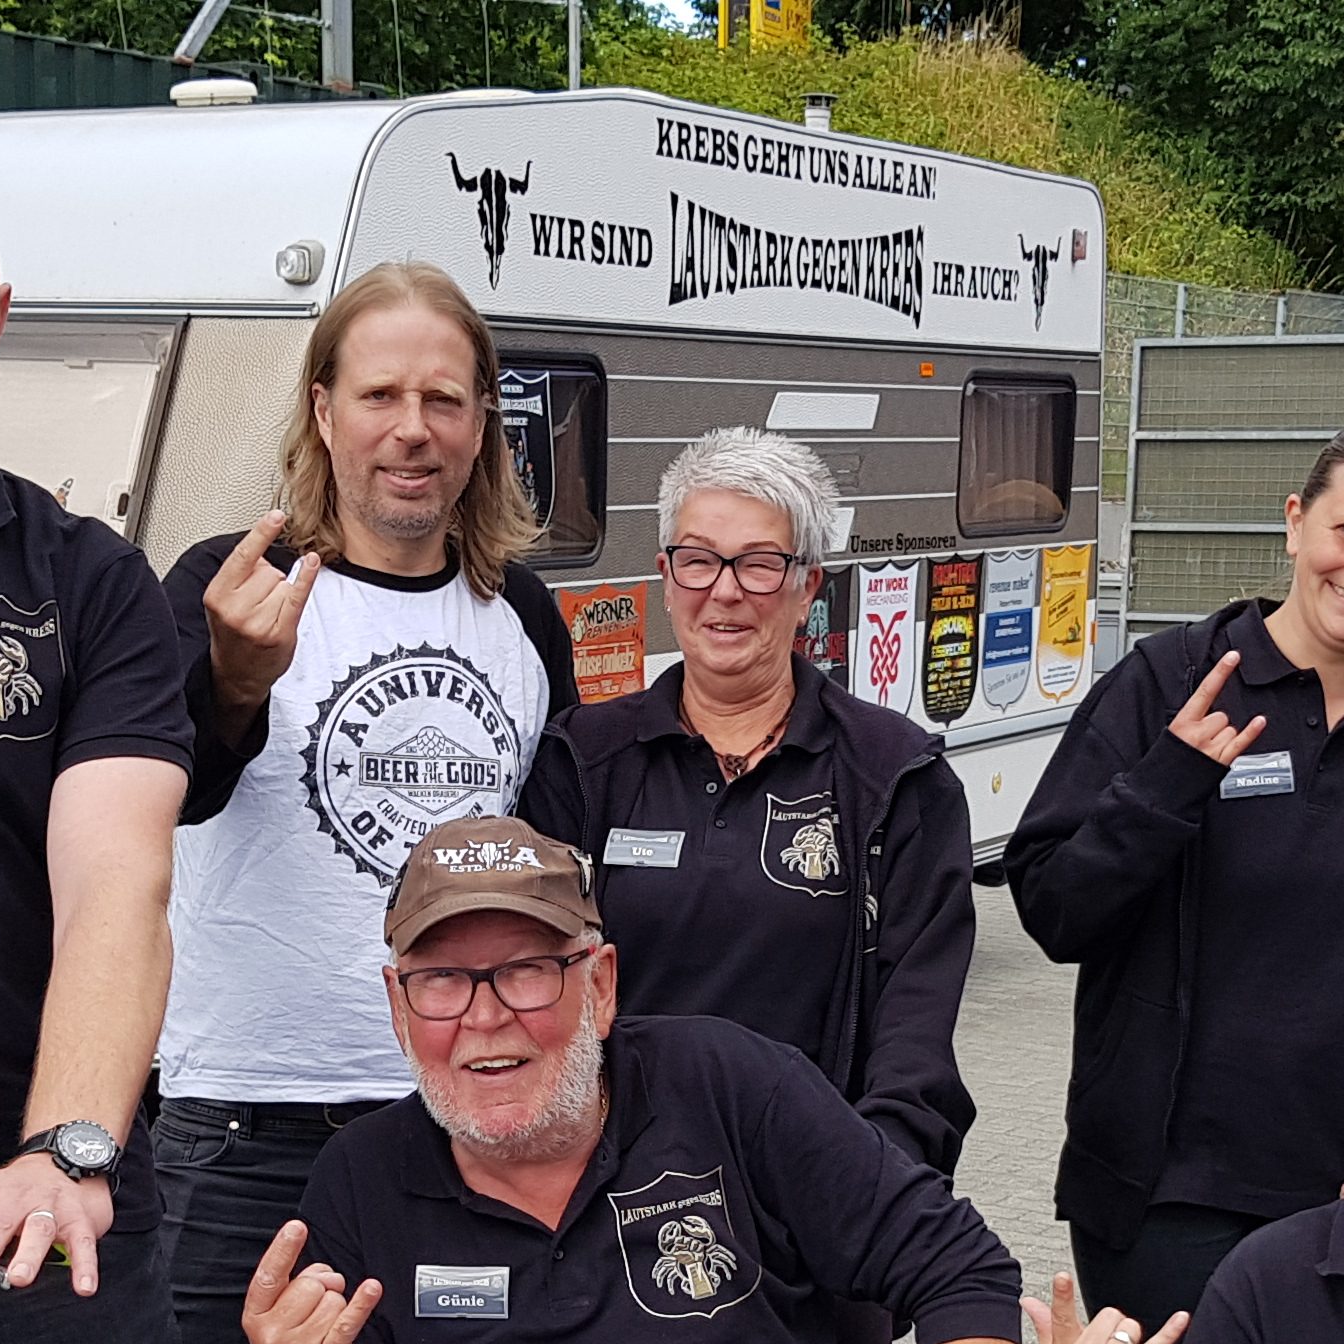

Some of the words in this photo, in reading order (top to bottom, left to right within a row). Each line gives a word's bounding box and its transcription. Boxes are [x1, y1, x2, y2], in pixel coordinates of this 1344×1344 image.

[657, 117, 739, 171] KREBS
[743, 134, 806, 180] GEHT
[808, 146, 849, 188] UNS
[852, 154, 904, 195] ALLE
[906, 163, 937, 200] AN!
[529, 212, 586, 261] WIR
[591, 220, 653, 268] SIND
[668, 190, 794, 306] LAUTSTARK
[796, 237, 863, 297] GEGEN
[863, 224, 926, 330] KREBS
[932, 261, 965, 297] IHR
[966, 266, 1020, 302] AUCH?
[850, 535, 894, 553] Unsere
[895, 532, 958, 553] Sponsoren
[867, 577, 885, 593] ART
[885, 576, 909, 593] WORX
[583, 597, 636, 624] WERNER
[338, 719, 369, 748] A
[355, 670, 511, 756] UNIVERSE
[365, 758, 419, 784] BEER
[446, 761, 496, 787] GODS
[1236, 776, 1280, 788] Nadine
[351, 810, 394, 850] OF
[376, 798, 428, 836] CRAFTED
[449, 863, 486, 873] ESTD.
[496, 862, 523, 873] 1990
[621, 1200, 677, 1226] LAUTSTARK
